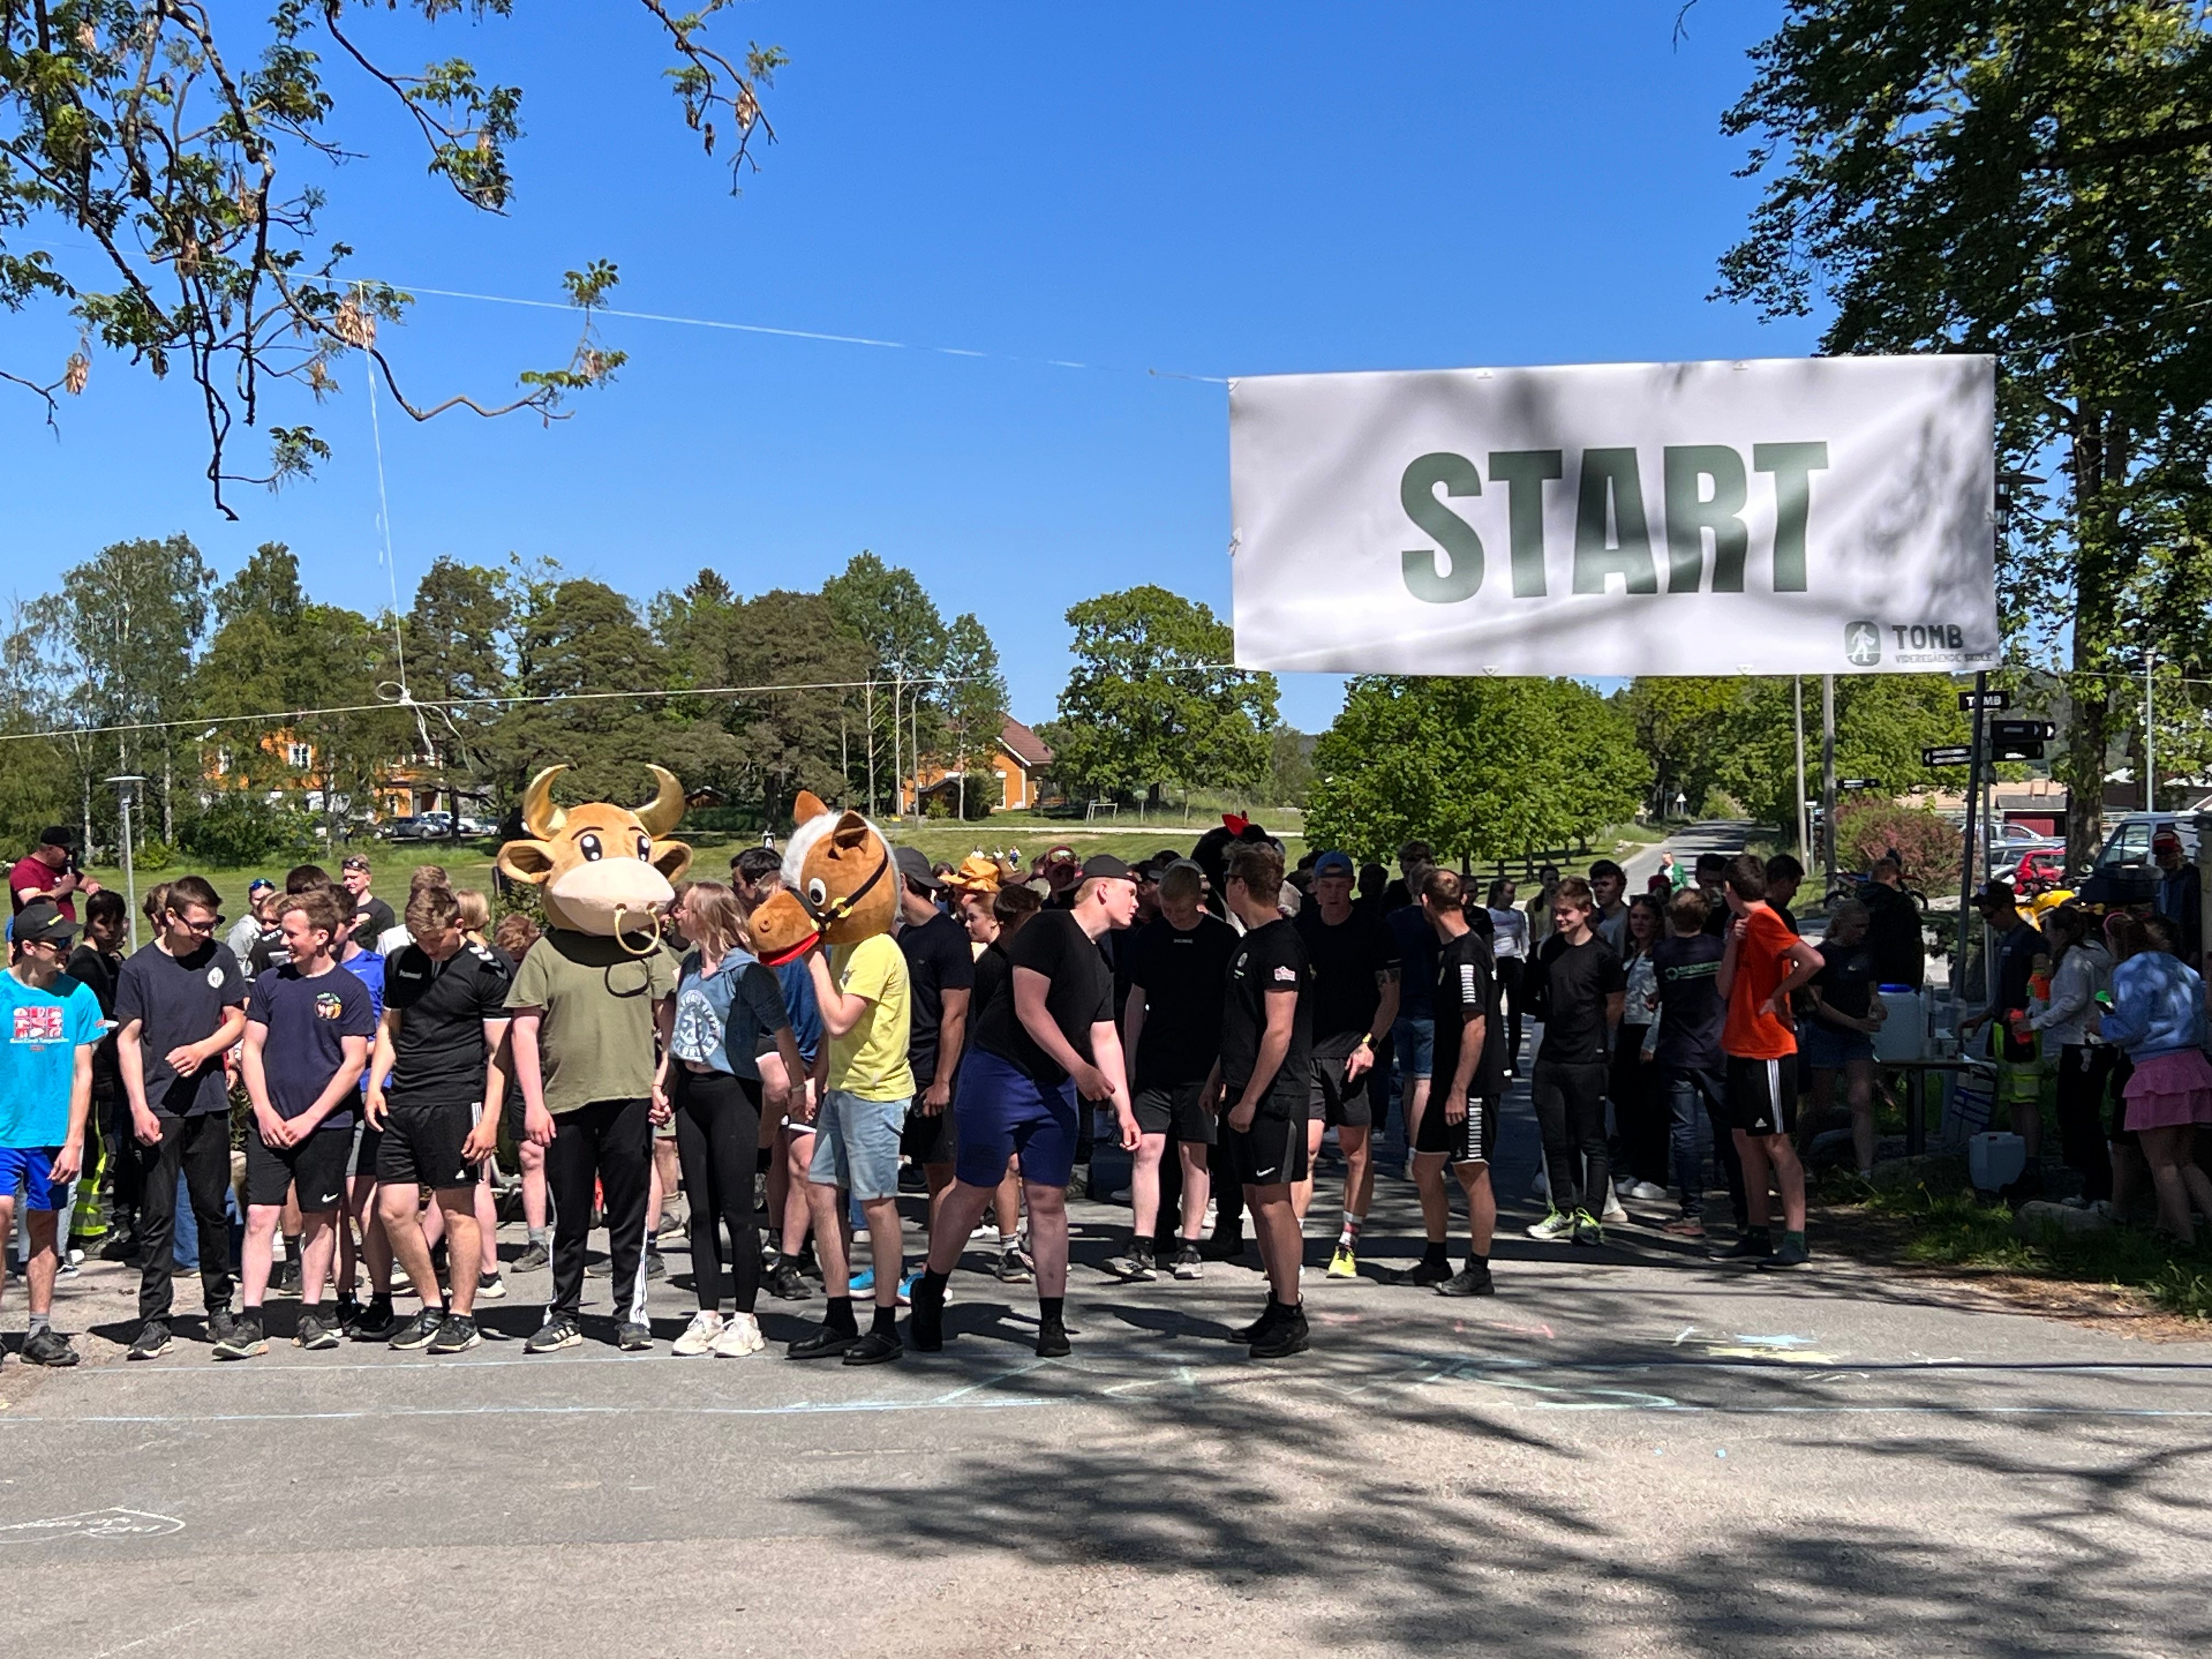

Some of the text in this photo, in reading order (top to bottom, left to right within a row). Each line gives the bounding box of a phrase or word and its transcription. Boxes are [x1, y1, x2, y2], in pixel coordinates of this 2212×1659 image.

[1400, 442, 1829, 603] START
[1892, 624, 1963, 650] TOMB
[1966, 695, 2002, 707] TMB
